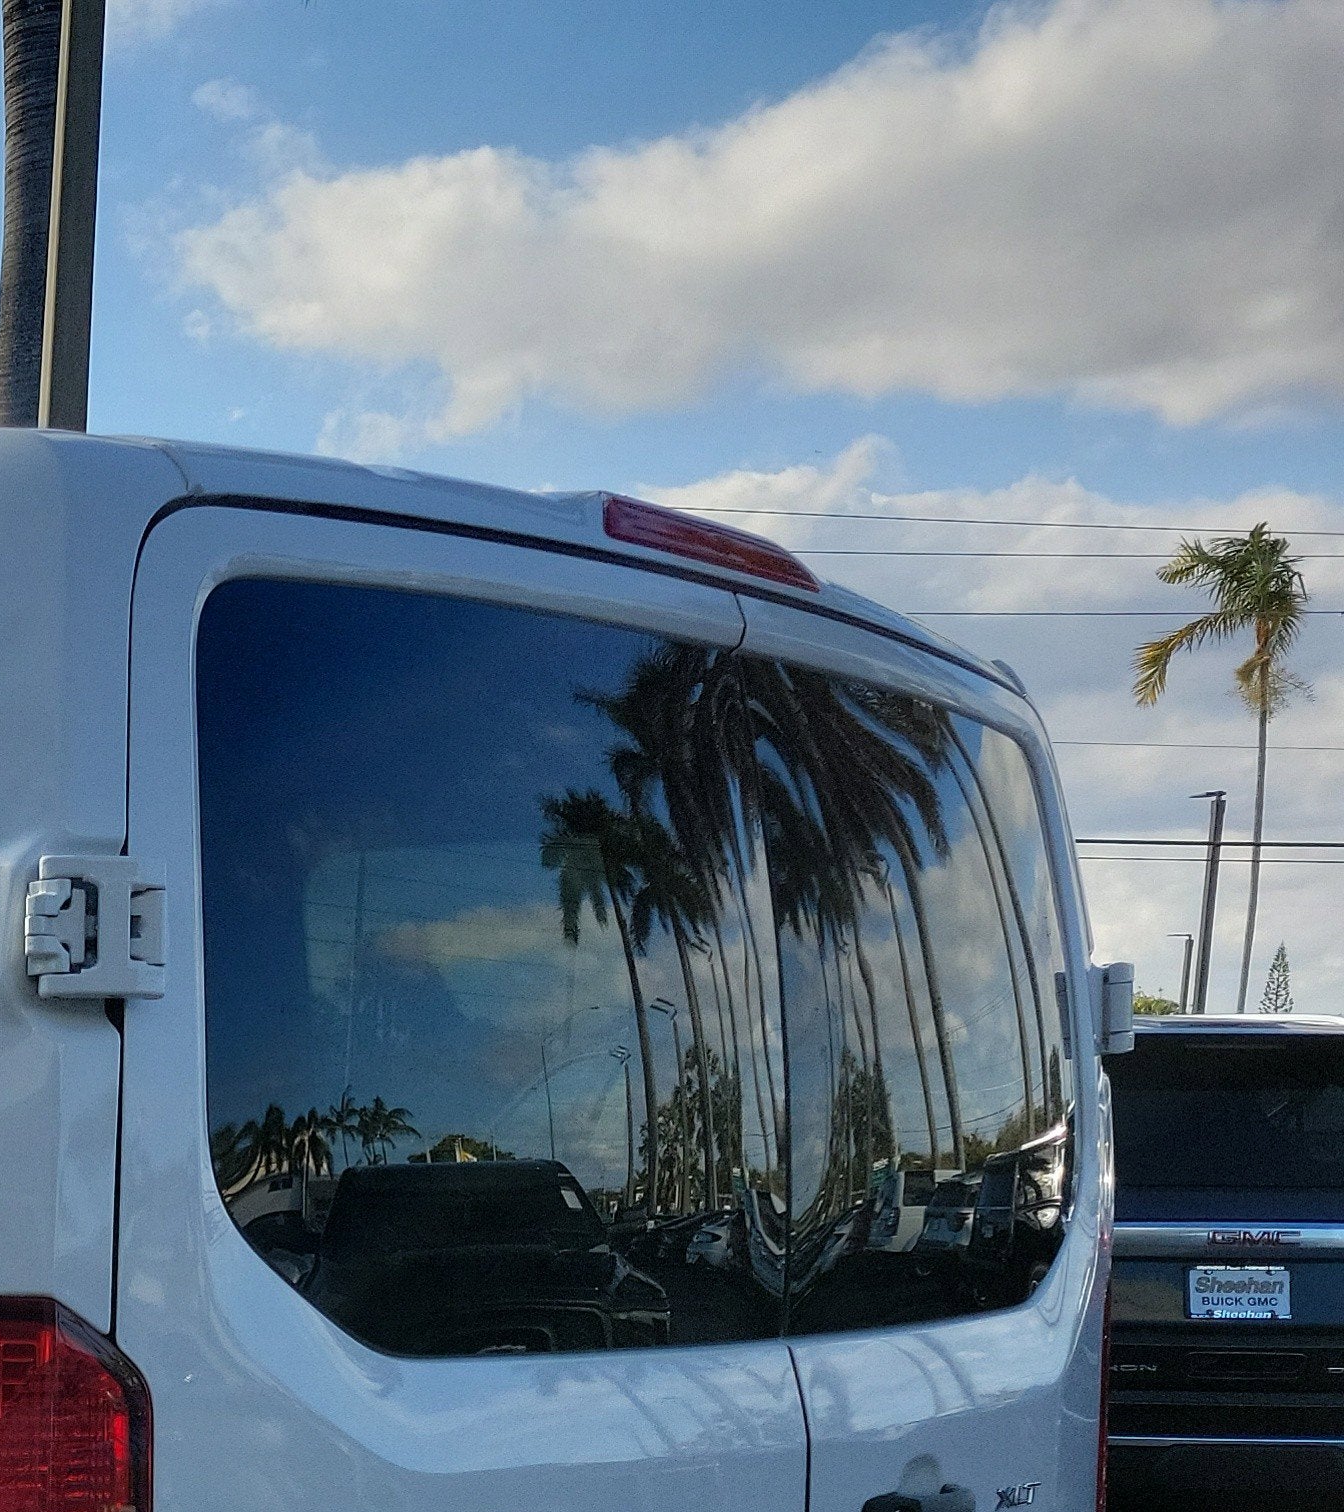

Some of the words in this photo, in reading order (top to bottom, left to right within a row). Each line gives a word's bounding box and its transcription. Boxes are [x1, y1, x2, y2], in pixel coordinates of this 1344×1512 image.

[1208, 1230, 1301, 1246] GMC
[1195, 1276, 1285, 1294] Sheehan
[1202, 1297, 1244, 1306] BUICK
[1248, 1297, 1279, 1306] GMC
[994, 1481, 1042, 1512] XLT
